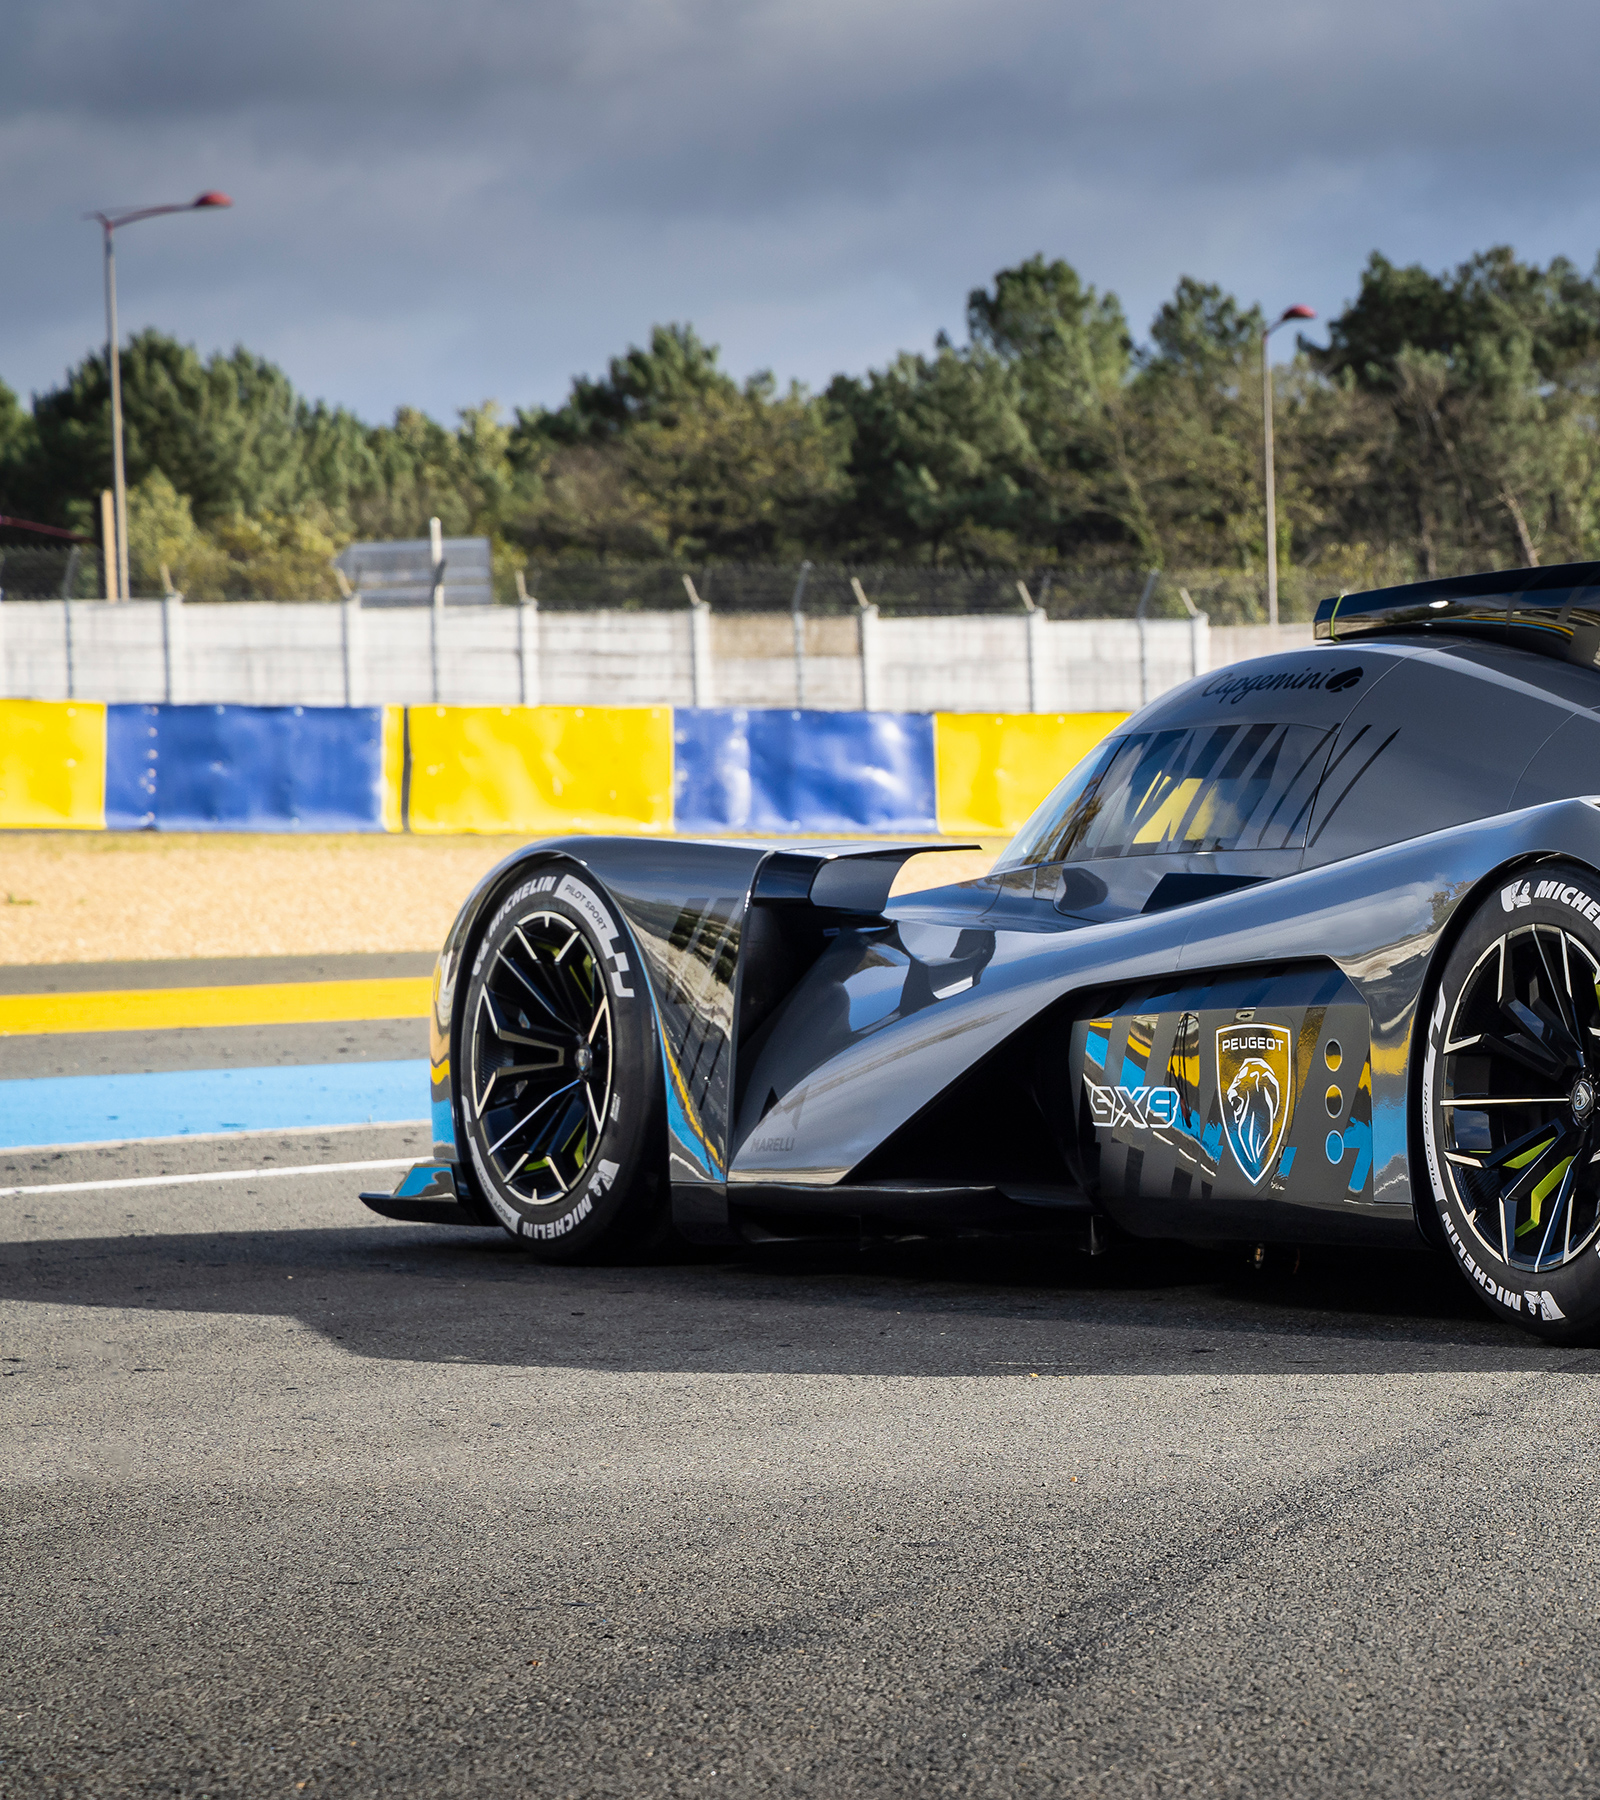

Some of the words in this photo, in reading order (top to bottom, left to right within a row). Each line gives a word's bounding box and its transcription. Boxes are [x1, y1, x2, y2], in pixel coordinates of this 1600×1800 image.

[1202, 666, 1336, 705] Capgemini
[488, 876, 557, 938] MICHELIN
[565, 883, 587, 902] PILOT
[584, 900, 608, 930] SPORT
[1222, 1037, 1284, 1051] PEUGEOT
[750, 1137, 795, 1152] MARELLI
[523, 1193, 593, 1240] MICHELIN
[1441, 1211, 1522, 1312] MICHELIN
